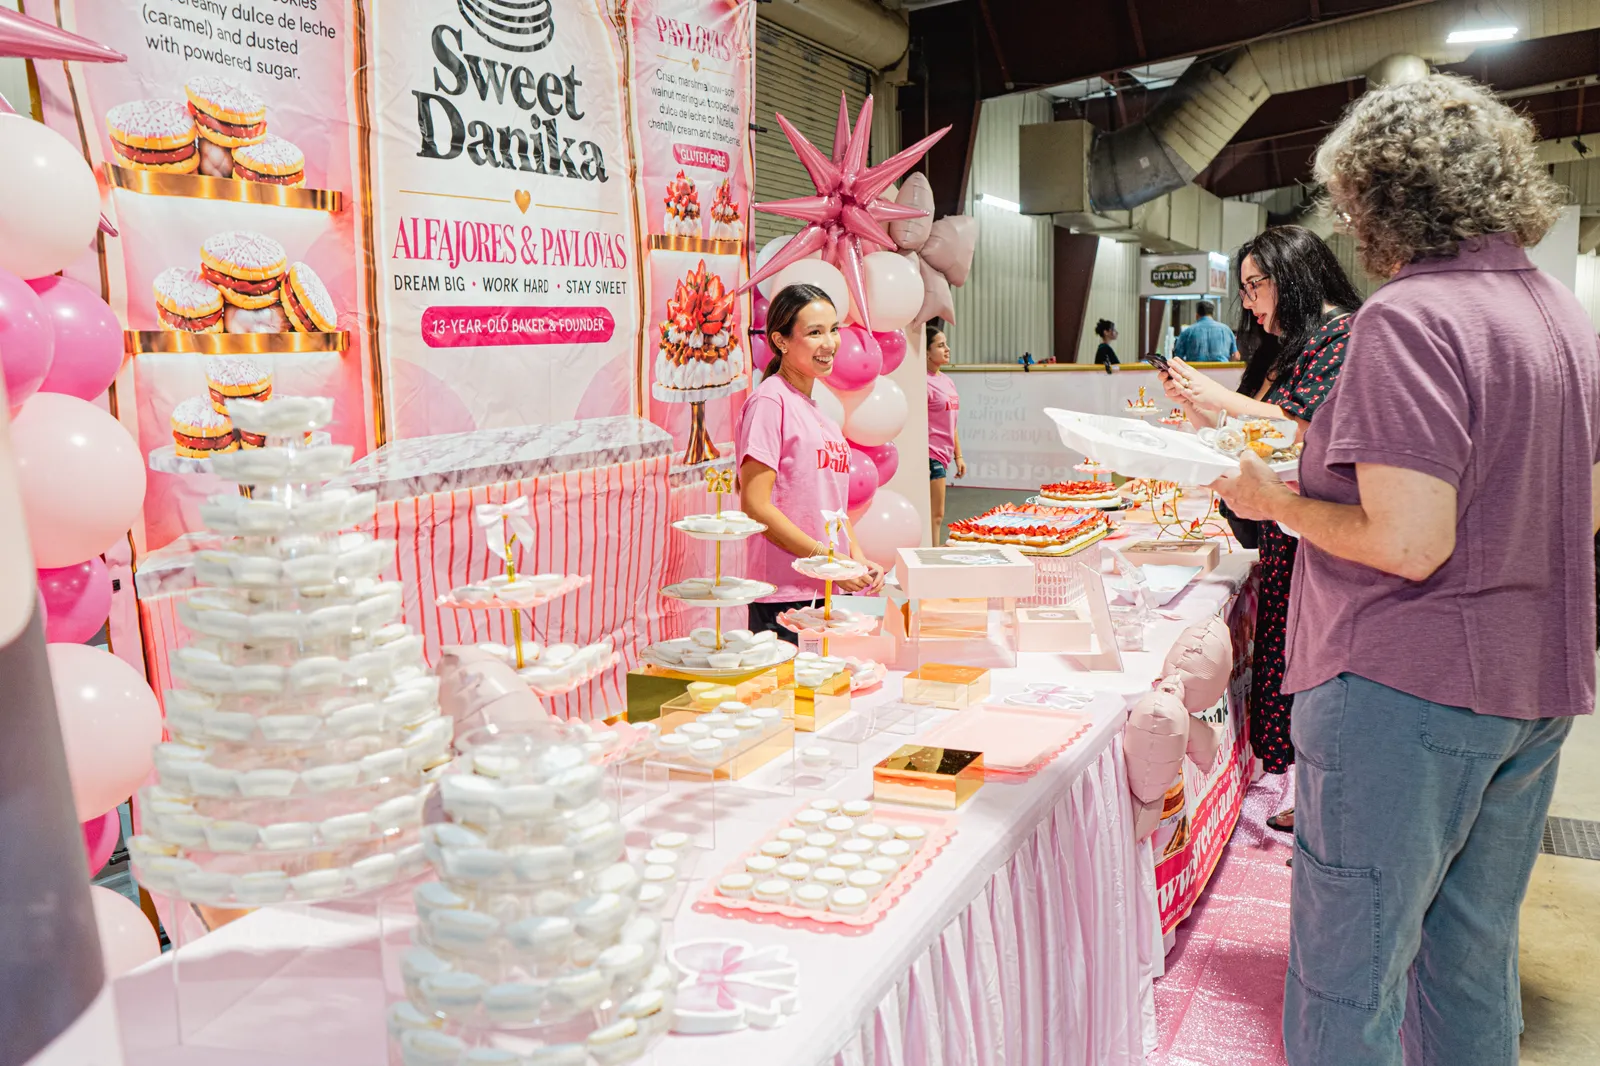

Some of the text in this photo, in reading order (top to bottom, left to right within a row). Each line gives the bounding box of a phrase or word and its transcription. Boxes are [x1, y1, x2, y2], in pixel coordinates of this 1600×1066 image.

[142, 3, 298, 55] (caramel) and dusted
[231, 4, 274, 25] dulce
[278, 13, 296, 30] de
[300, 16, 336, 39] leche
[655, 14, 731, 62] PAVLOVAS
[145, 34, 301, 80] with powdered sugar.
[431, 24, 585, 121] Sweet
[411, 89, 609, 183] Danika
[680, 148, 726, 168] GLUTEN-FREE
[392, 216, 627, 270] ALFAJORES & PAVLOVAS
[394, 275, 627, 295] DREAM BIG WORK HARD STAY SWEET
[1152, 271, 1194, 281] CITY GATE
[432, 318, 605, 335] 13-YEAR-OLD BAKER & FOUNDER
